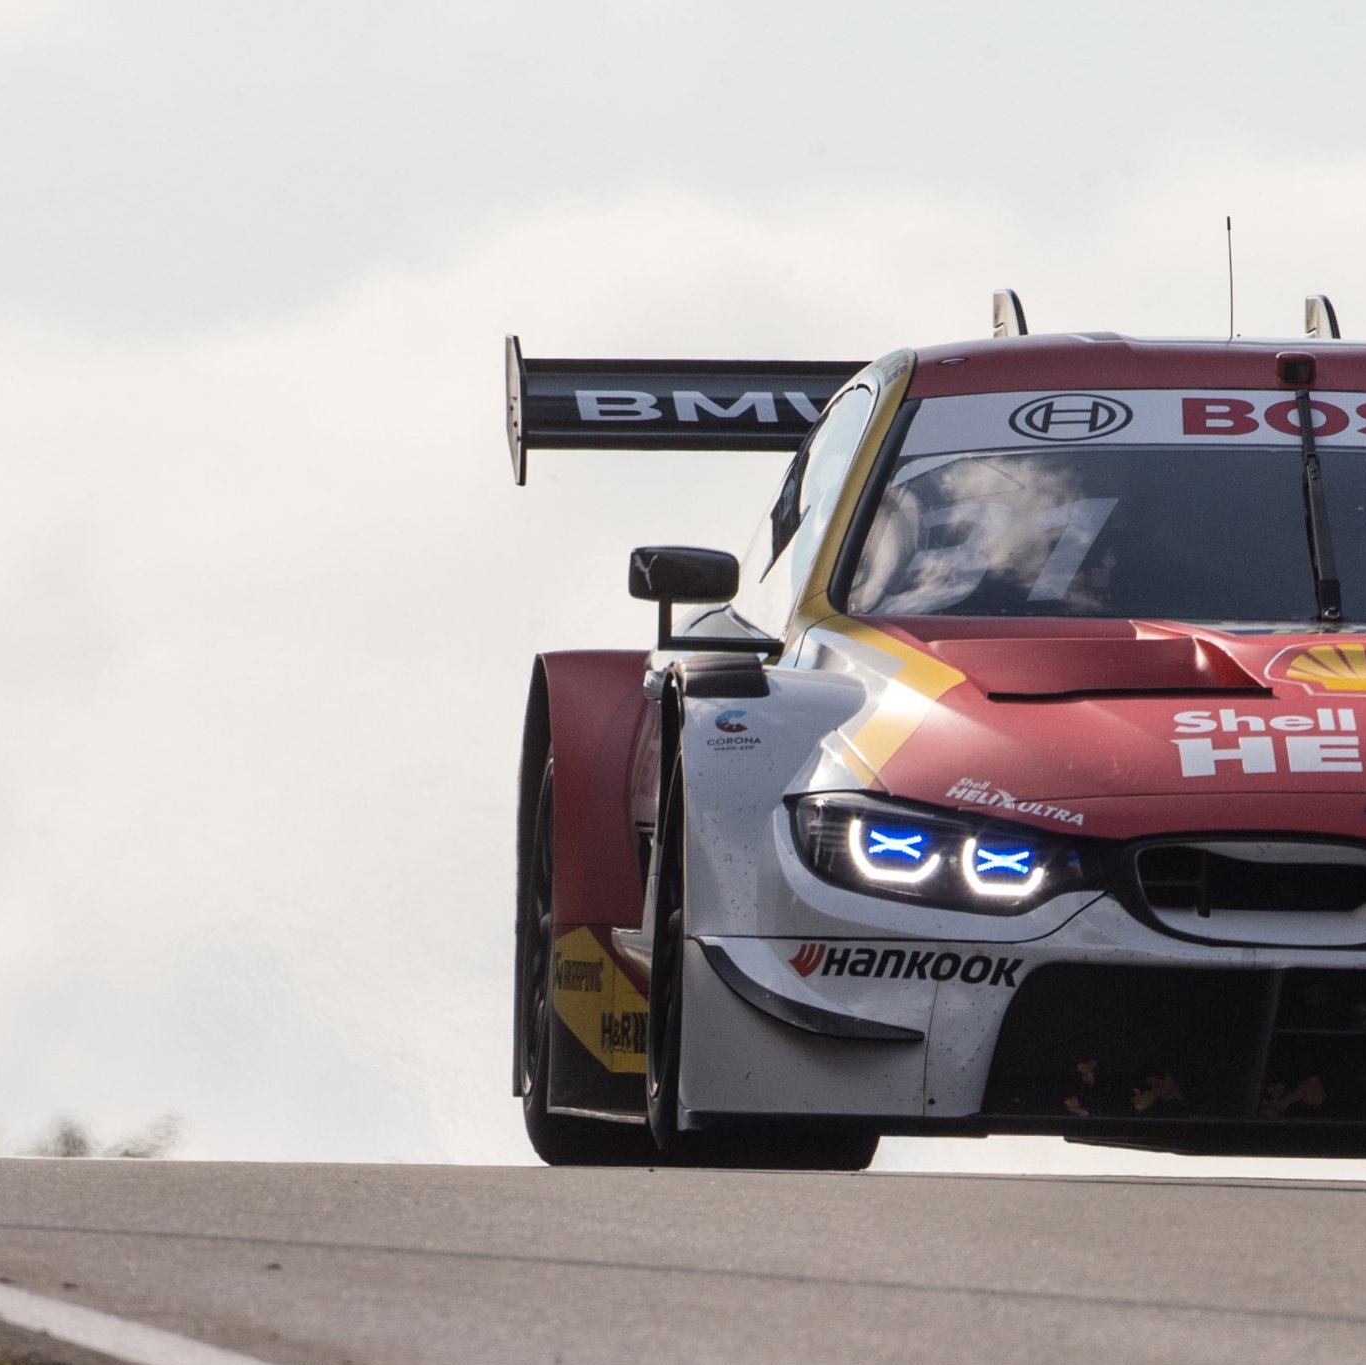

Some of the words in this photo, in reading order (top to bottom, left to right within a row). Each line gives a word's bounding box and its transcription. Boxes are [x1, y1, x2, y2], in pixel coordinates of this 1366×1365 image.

[1173, 708, 1357, 733] Shell
[706, 736, 762, 747] CORONA
[957, 777, 992, 790] Shell
[945, 785, 1017, 809] HELIX
[1017, 801, 1085, 826] ULTRA
